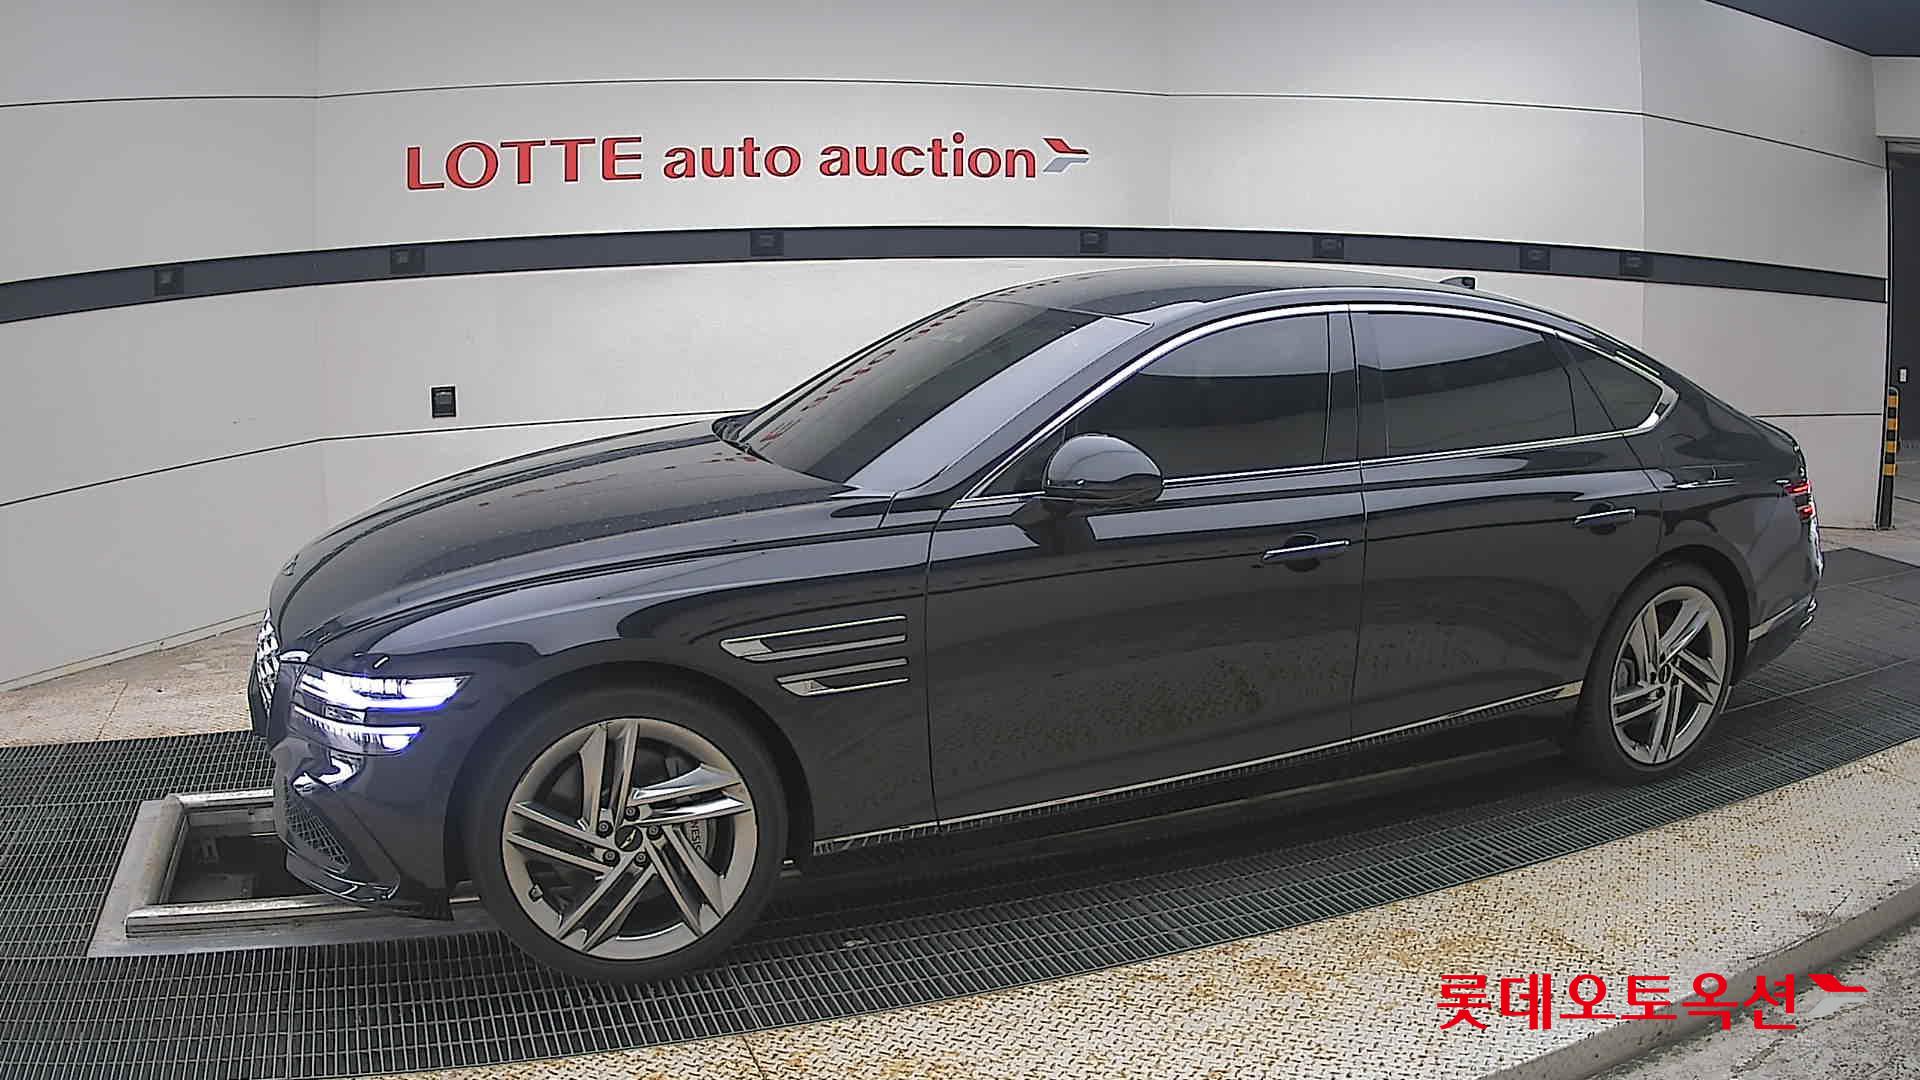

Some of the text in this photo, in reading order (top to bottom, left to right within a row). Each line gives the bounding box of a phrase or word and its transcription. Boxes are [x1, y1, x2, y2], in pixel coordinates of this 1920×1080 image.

[406, 133, 1037, 190] LOTTE auto auction
